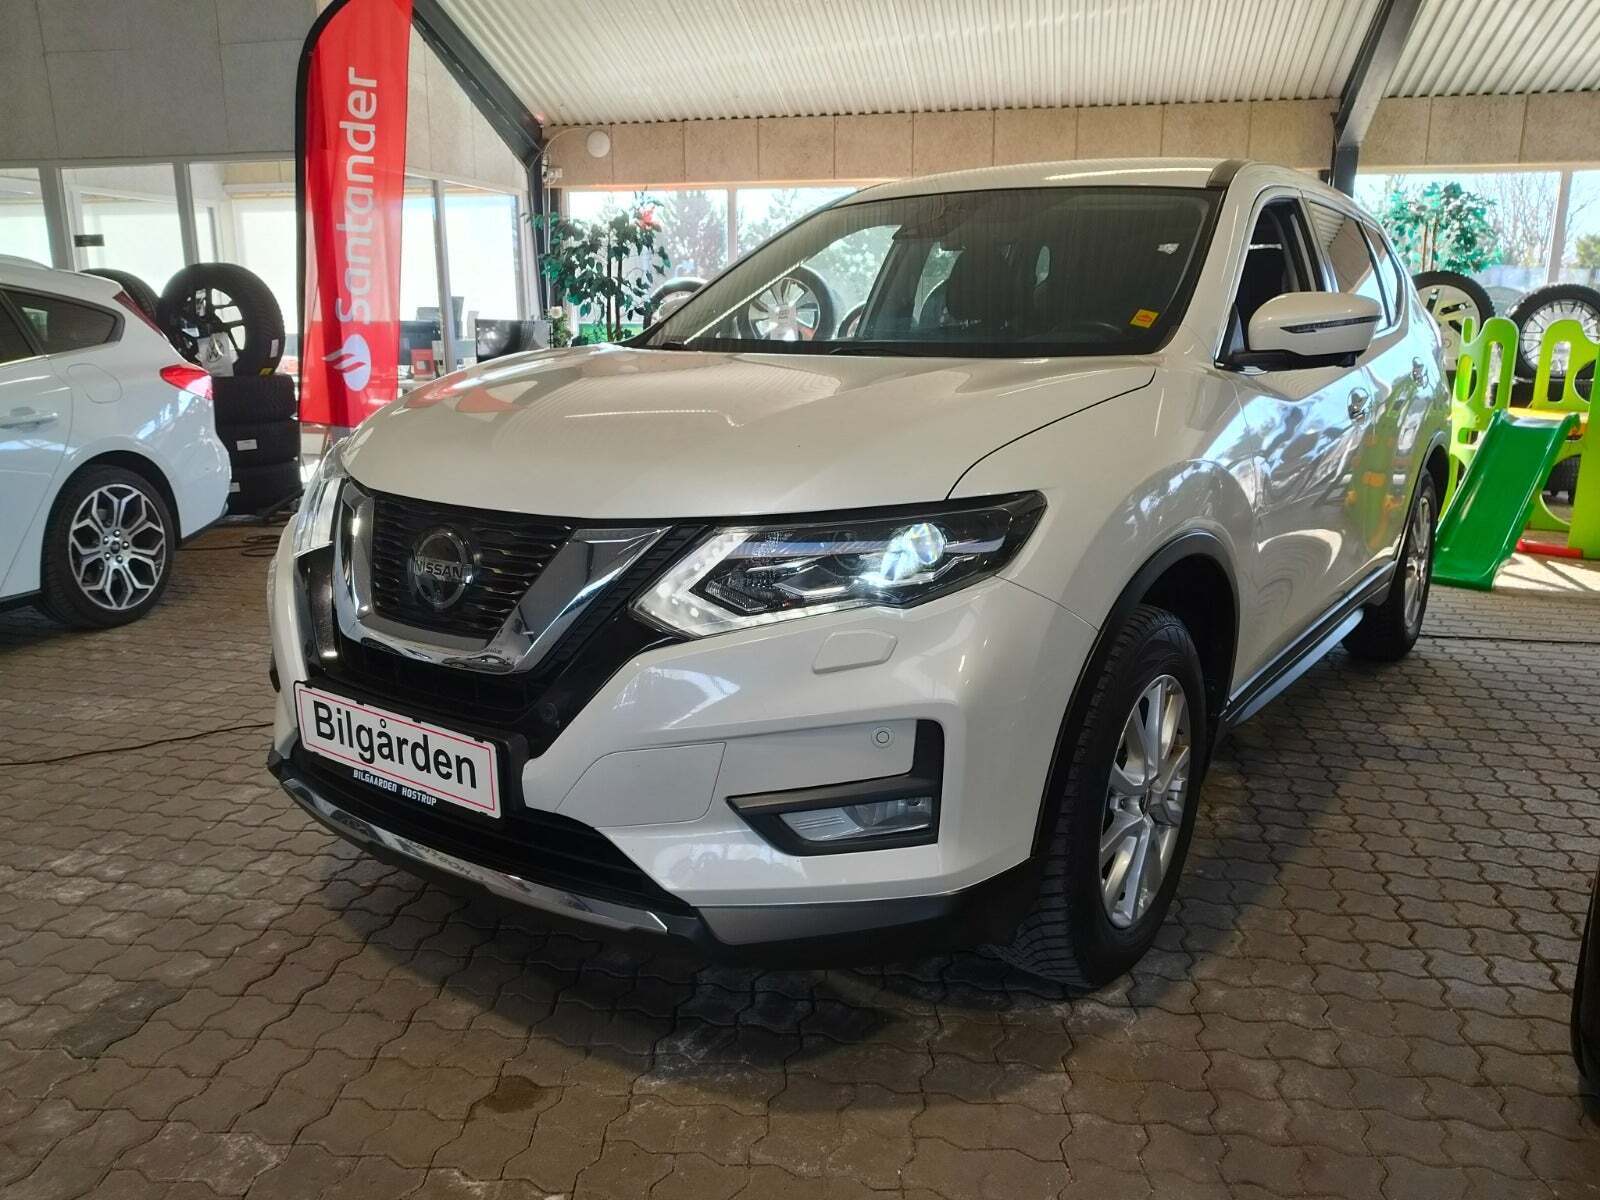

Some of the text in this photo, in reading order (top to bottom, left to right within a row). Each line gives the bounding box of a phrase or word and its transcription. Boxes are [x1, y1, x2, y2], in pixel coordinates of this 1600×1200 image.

[336, 66, 377, 325] Santander
[414, 555, 463, 578] NISSAN
[313, 700, 476, 789] Bilgården
[353, 769, 397, 792] BILGAARDEN
